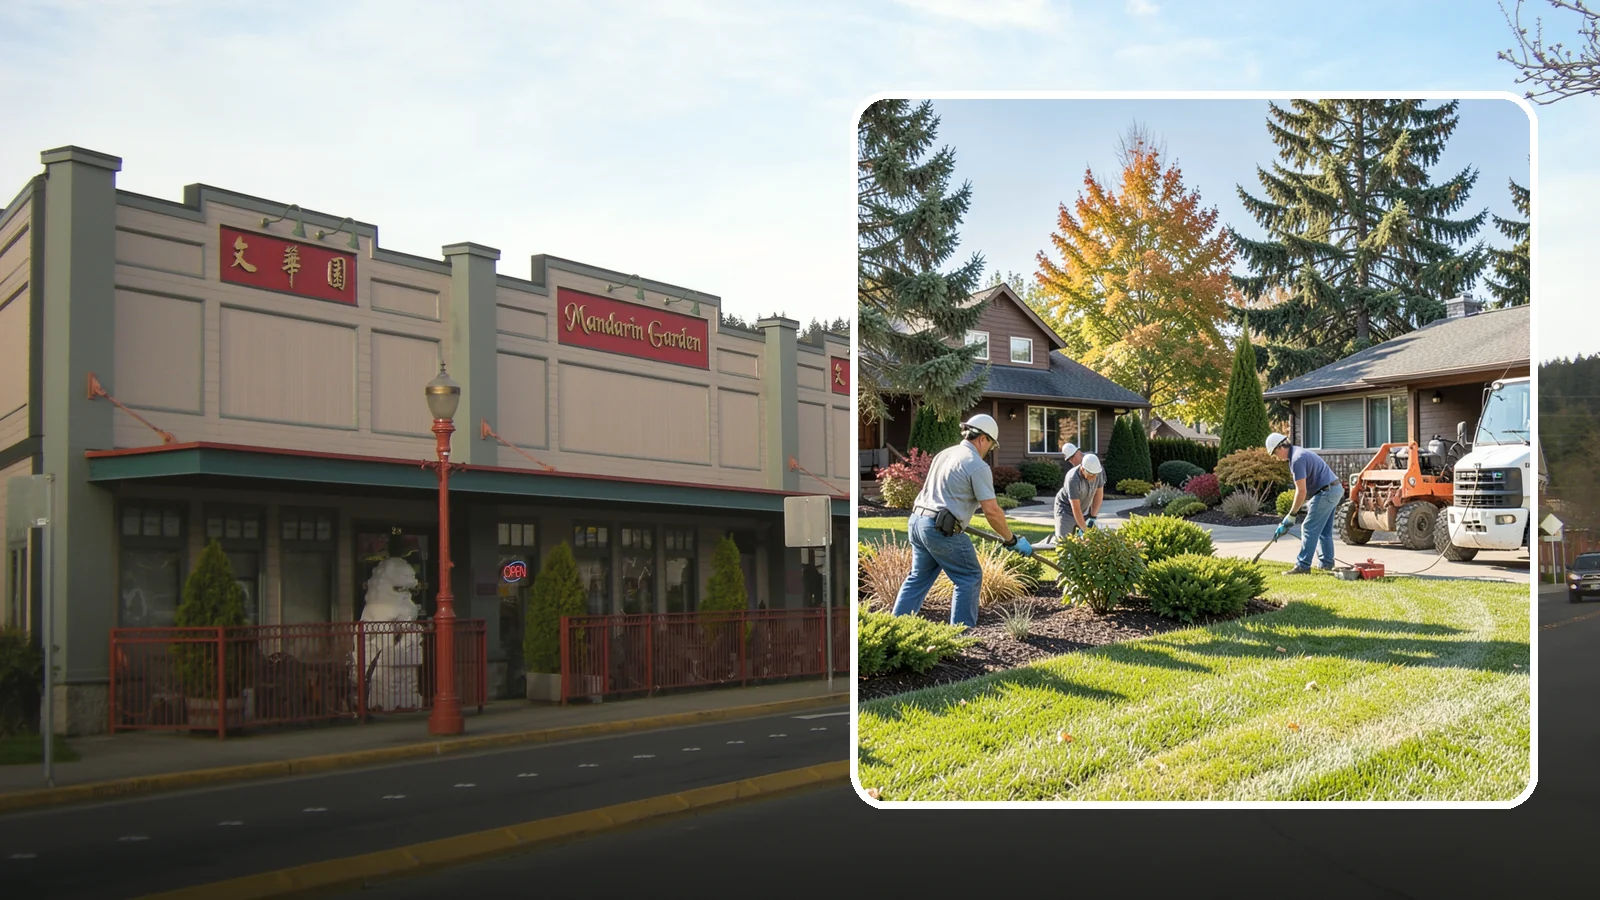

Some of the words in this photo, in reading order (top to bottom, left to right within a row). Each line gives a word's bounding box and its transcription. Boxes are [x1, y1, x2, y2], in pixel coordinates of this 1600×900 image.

[230, 236, 346, 291] 文華園
[564, 302, 644, 341] Mandarin
[648, 320, 701, 352] Garden
[503, 565, 526, 578] OPEN
